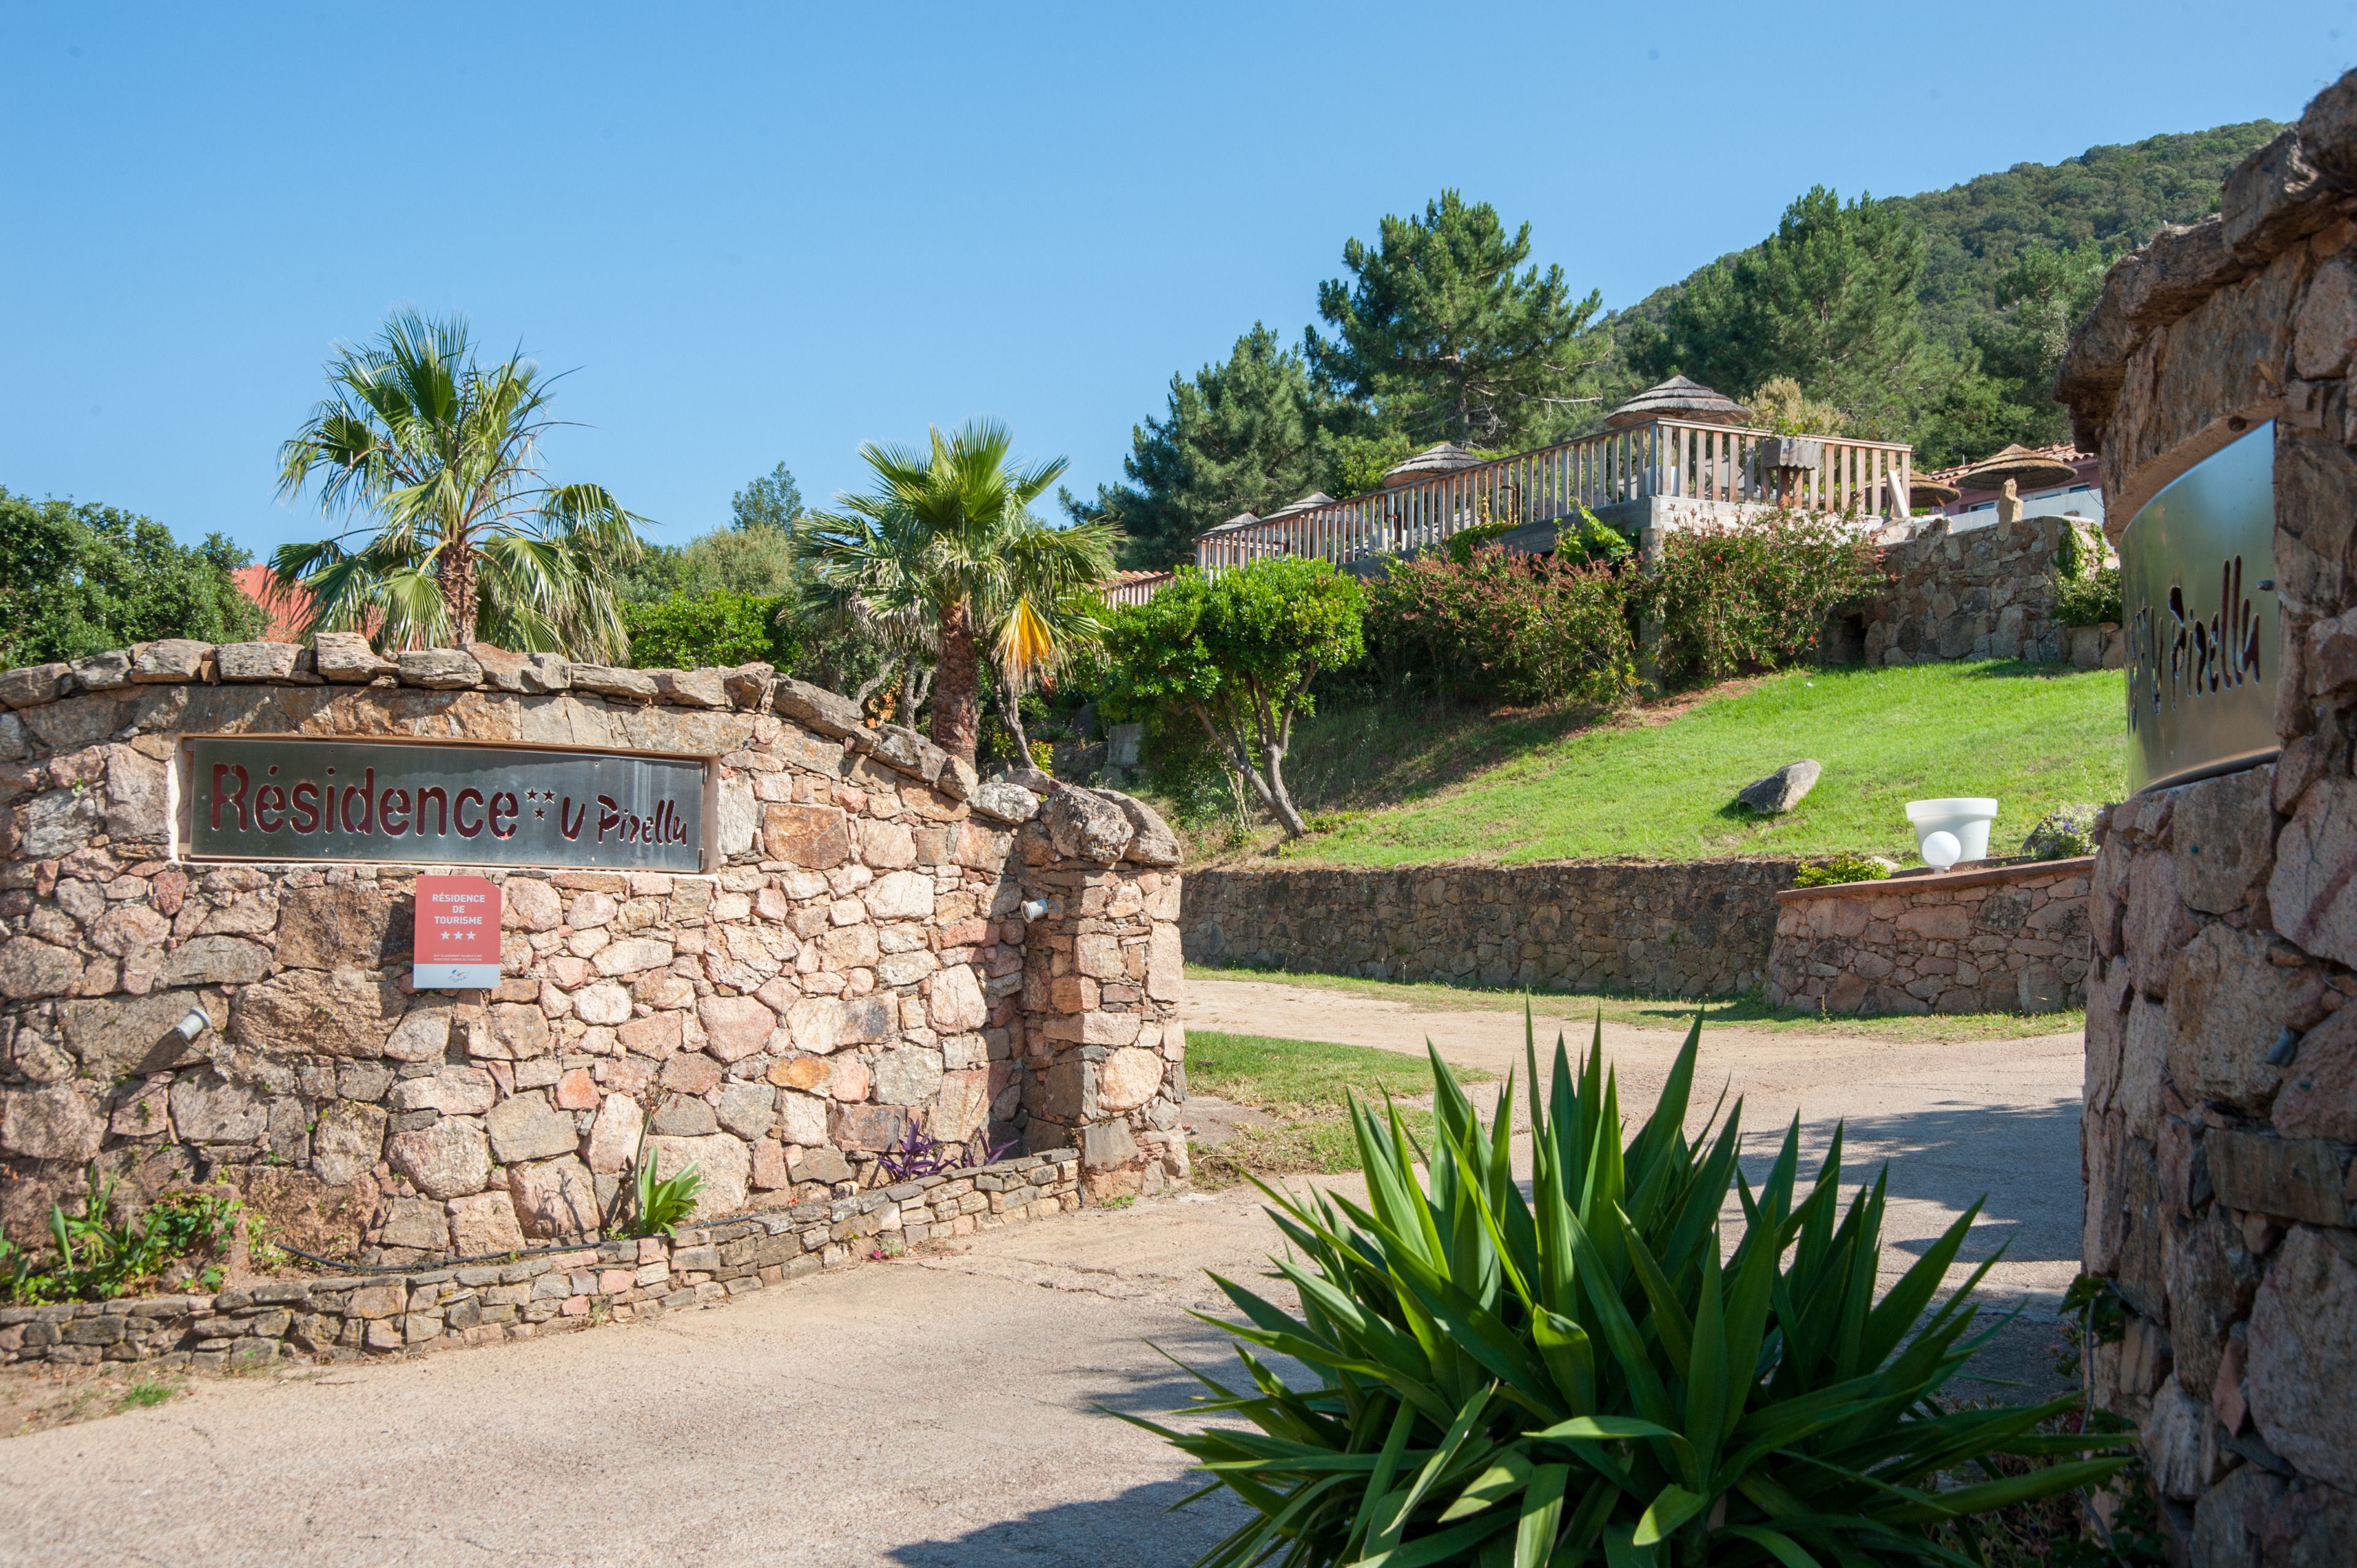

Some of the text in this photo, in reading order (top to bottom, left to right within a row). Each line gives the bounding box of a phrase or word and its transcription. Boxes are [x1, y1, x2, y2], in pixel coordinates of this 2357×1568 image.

[211, 763, 519, 840] Résidence
[560, 796, 587, 842] U
[432, 892, 486, 903] RÉSIDENCE
[452, 905, 465, 914] DE
[434, 916, 483, 925] TOURISME
